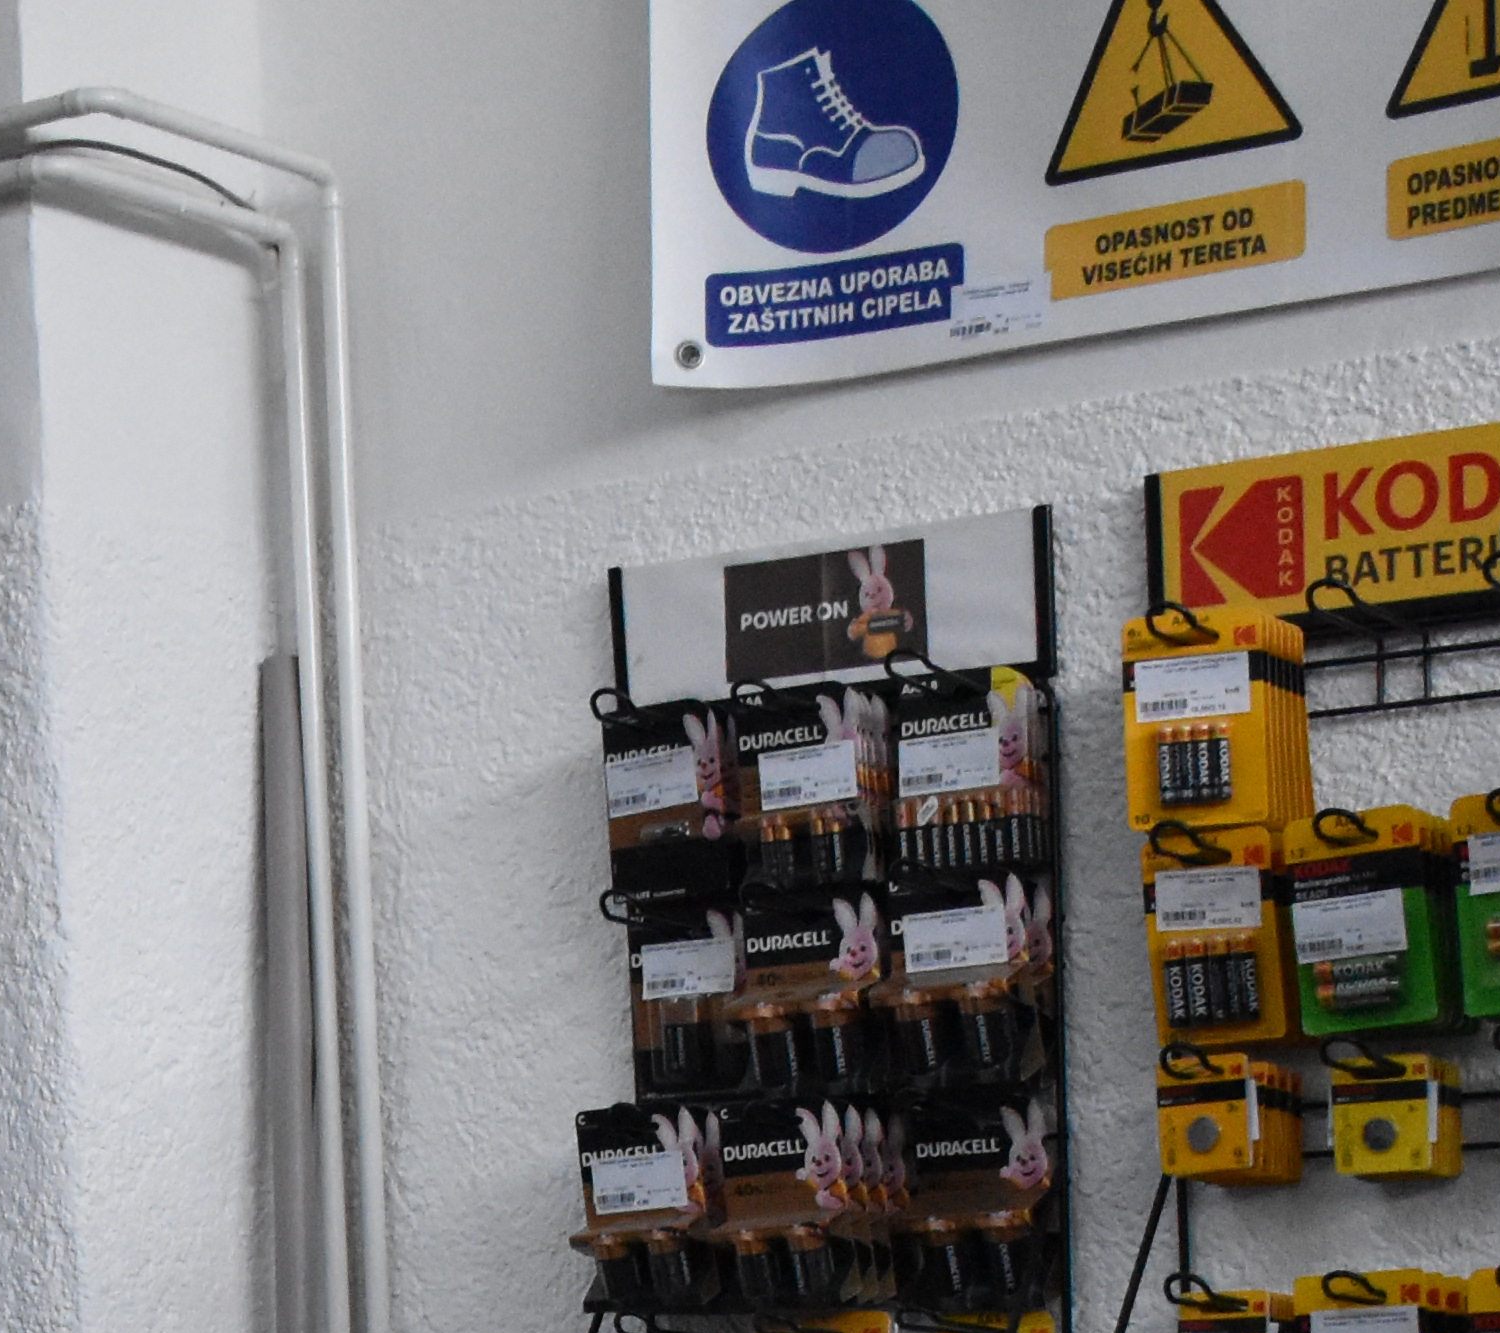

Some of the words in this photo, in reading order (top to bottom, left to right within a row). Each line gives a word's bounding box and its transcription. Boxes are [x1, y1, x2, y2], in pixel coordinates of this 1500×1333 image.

[1094, 213, 1215, 255] OPASNOST
[1222, 205, 1255, 231] OD
[719, 277, 834, 308] OBVEZNA
[839, 257, 950, 291] UPORABA
[1081, 249, 1173, 287] VISEĆIH
[1178, 234, 1268, 269] TERETA
[726, 299, 855, 334] ZAŠTITNIH
[860, 287, 943, 319] CIPELA
[1276, 485, 1295, 588] KODAK
[740, 605, 813, 631] POWER
[816, 600, 849, 622] ON
[738, 727, 823, 753] DURACELL
[900, 711, 990, 739] DURACELL
[746, 930, 833, 956] DURACELL
[1168, 965, 1185, 1019] KODAK
[1190, 962, 1208, 1017] KODAK
[1244, 958, 1261, 1011] KODAK
[723, 1140, 806, 1164] DURACELL
[915, 1137, 1000, 1160] DURACELL
